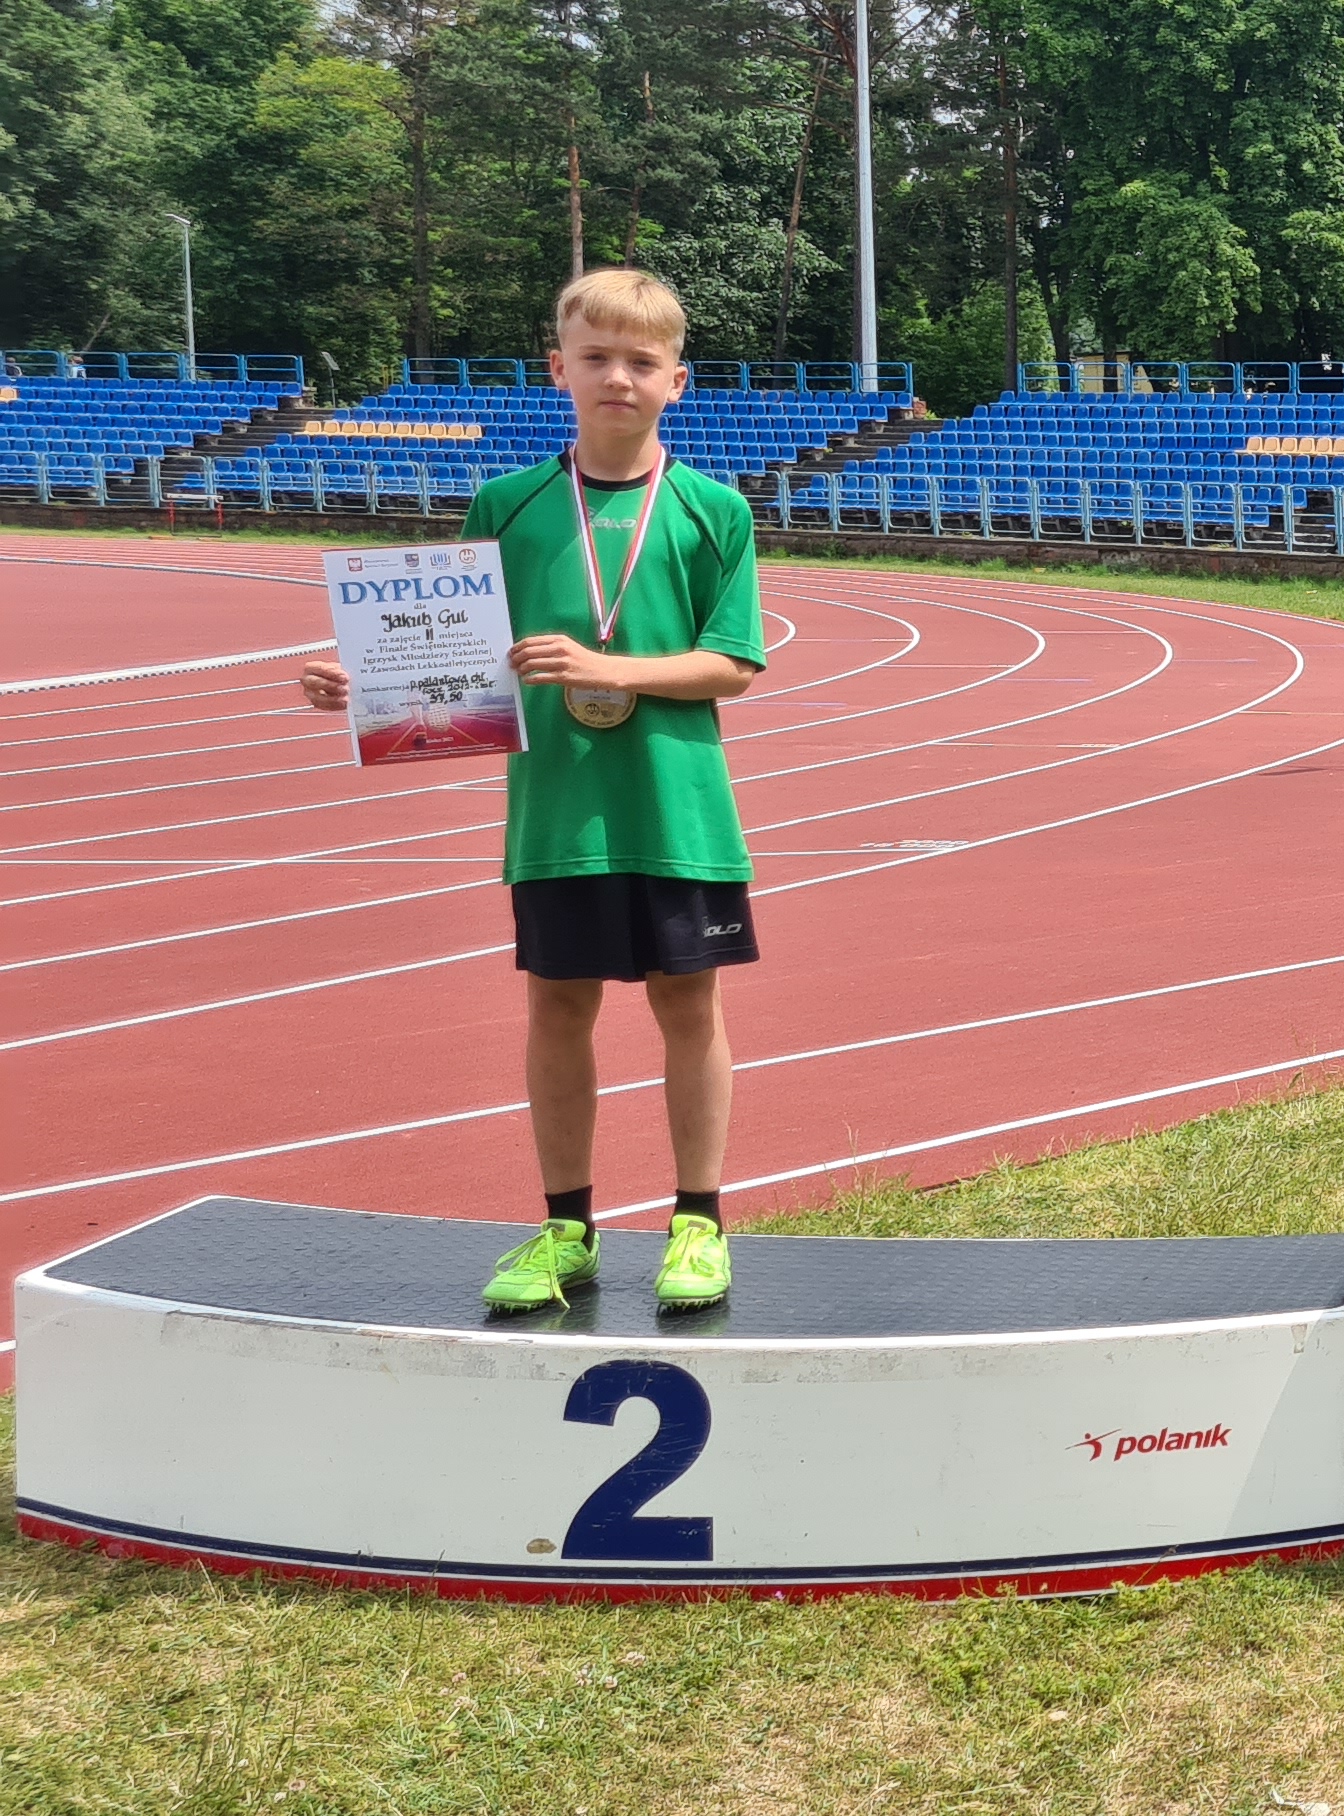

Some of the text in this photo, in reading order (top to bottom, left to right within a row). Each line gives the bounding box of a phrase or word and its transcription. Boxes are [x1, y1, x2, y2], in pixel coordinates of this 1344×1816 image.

[338, 572, 496, 604] DYPLOM
[381, 612, 432, 633] Jakub
[562, 1358, 714, 1562] 2
[1113, 1422, 1233, 1462] polanik
